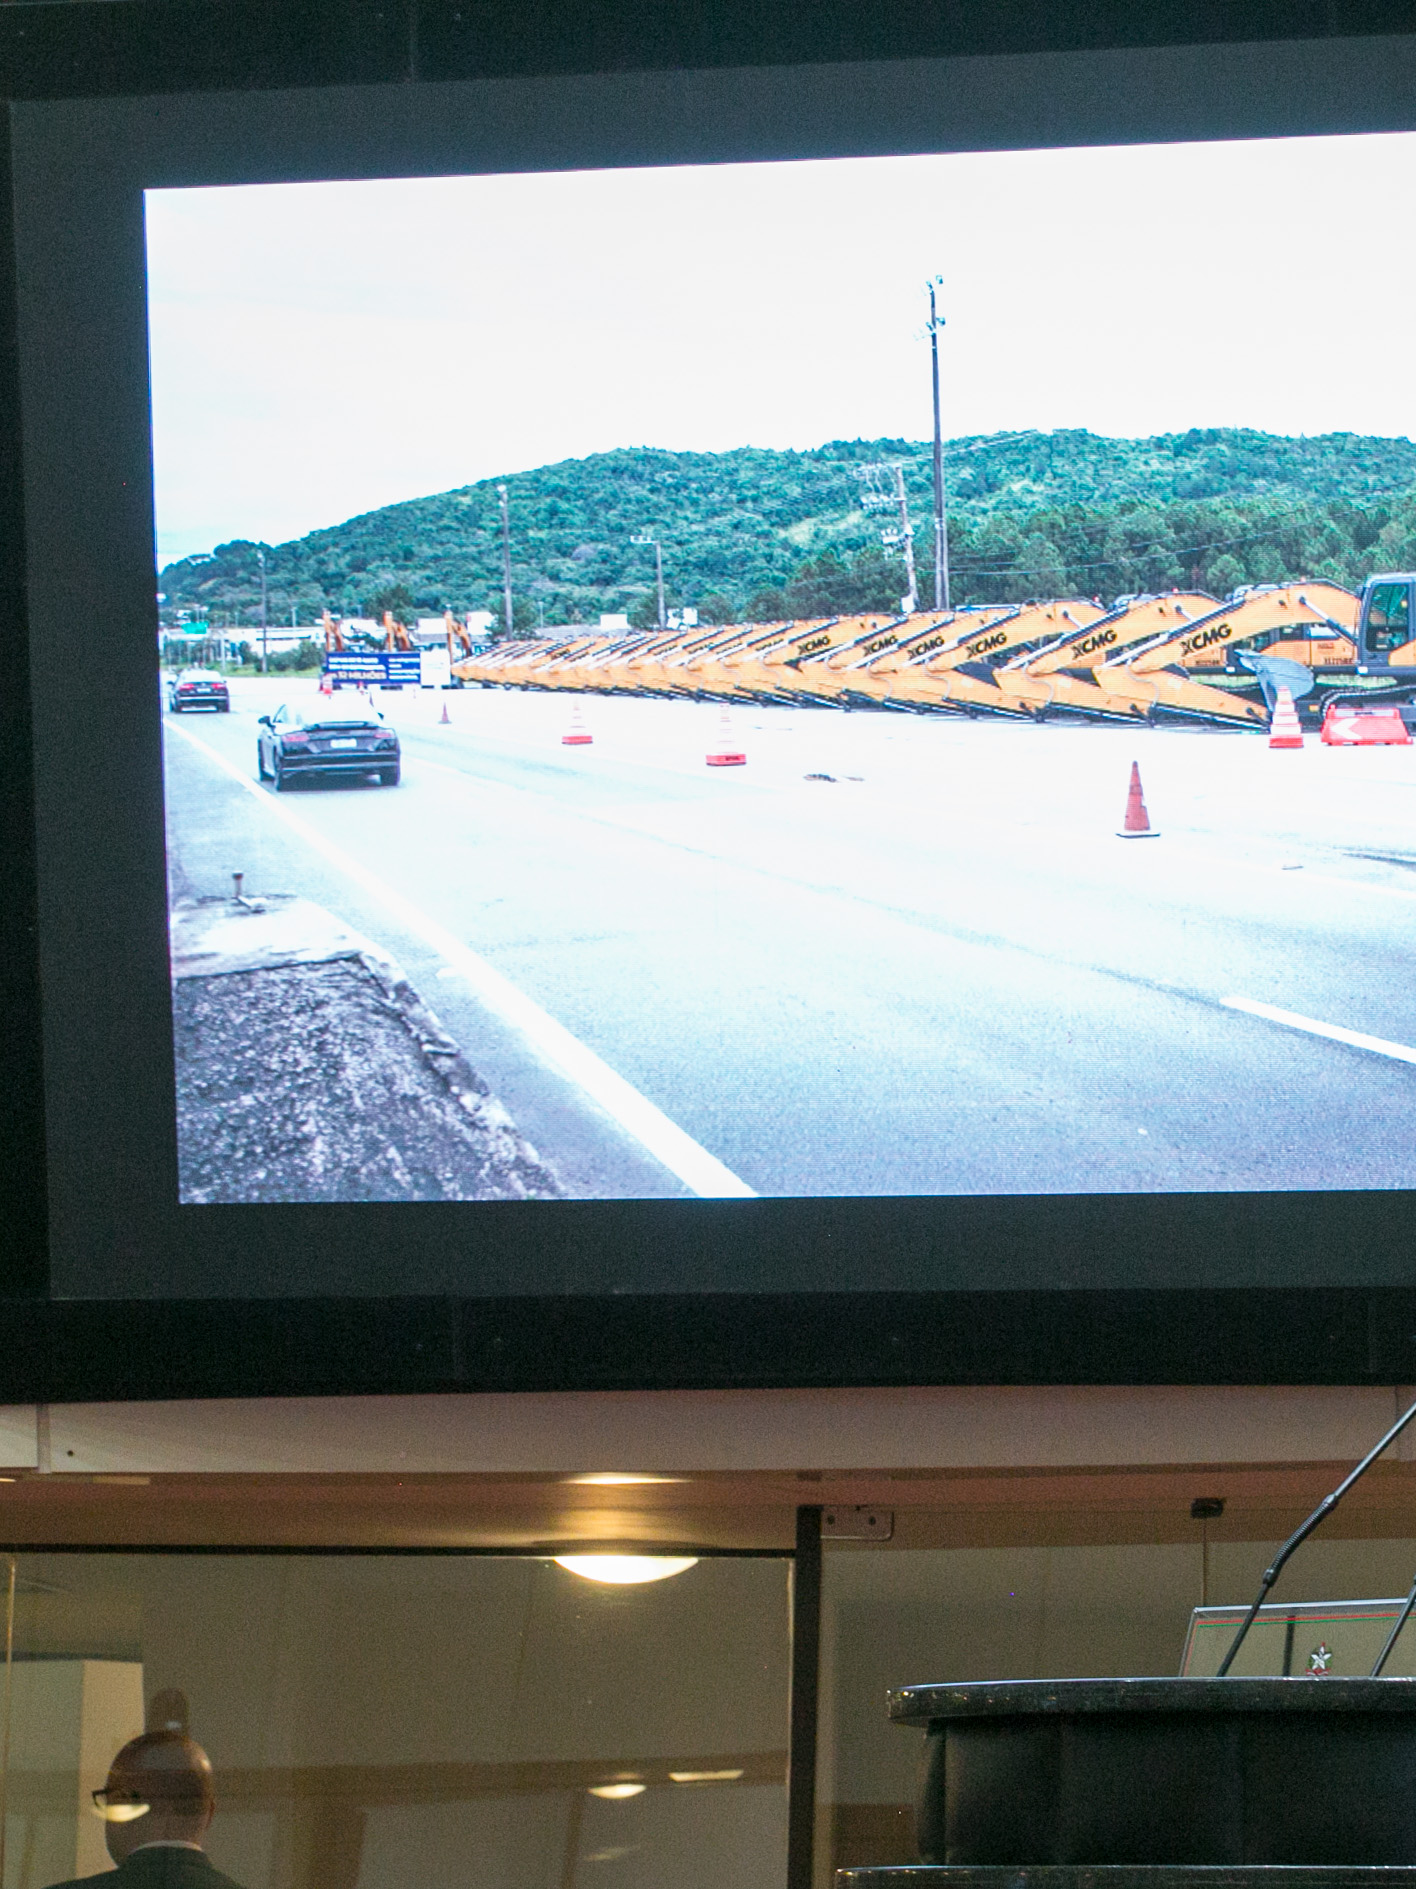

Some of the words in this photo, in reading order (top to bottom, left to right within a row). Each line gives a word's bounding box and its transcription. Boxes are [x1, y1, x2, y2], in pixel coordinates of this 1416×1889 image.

[907, 635, 946, 660] XCMG
[965, 631, 1008, 660] XCMG
[1071, 629, 1118, 660] XCMG
[1179, 623, 1232, 657] XCMG
